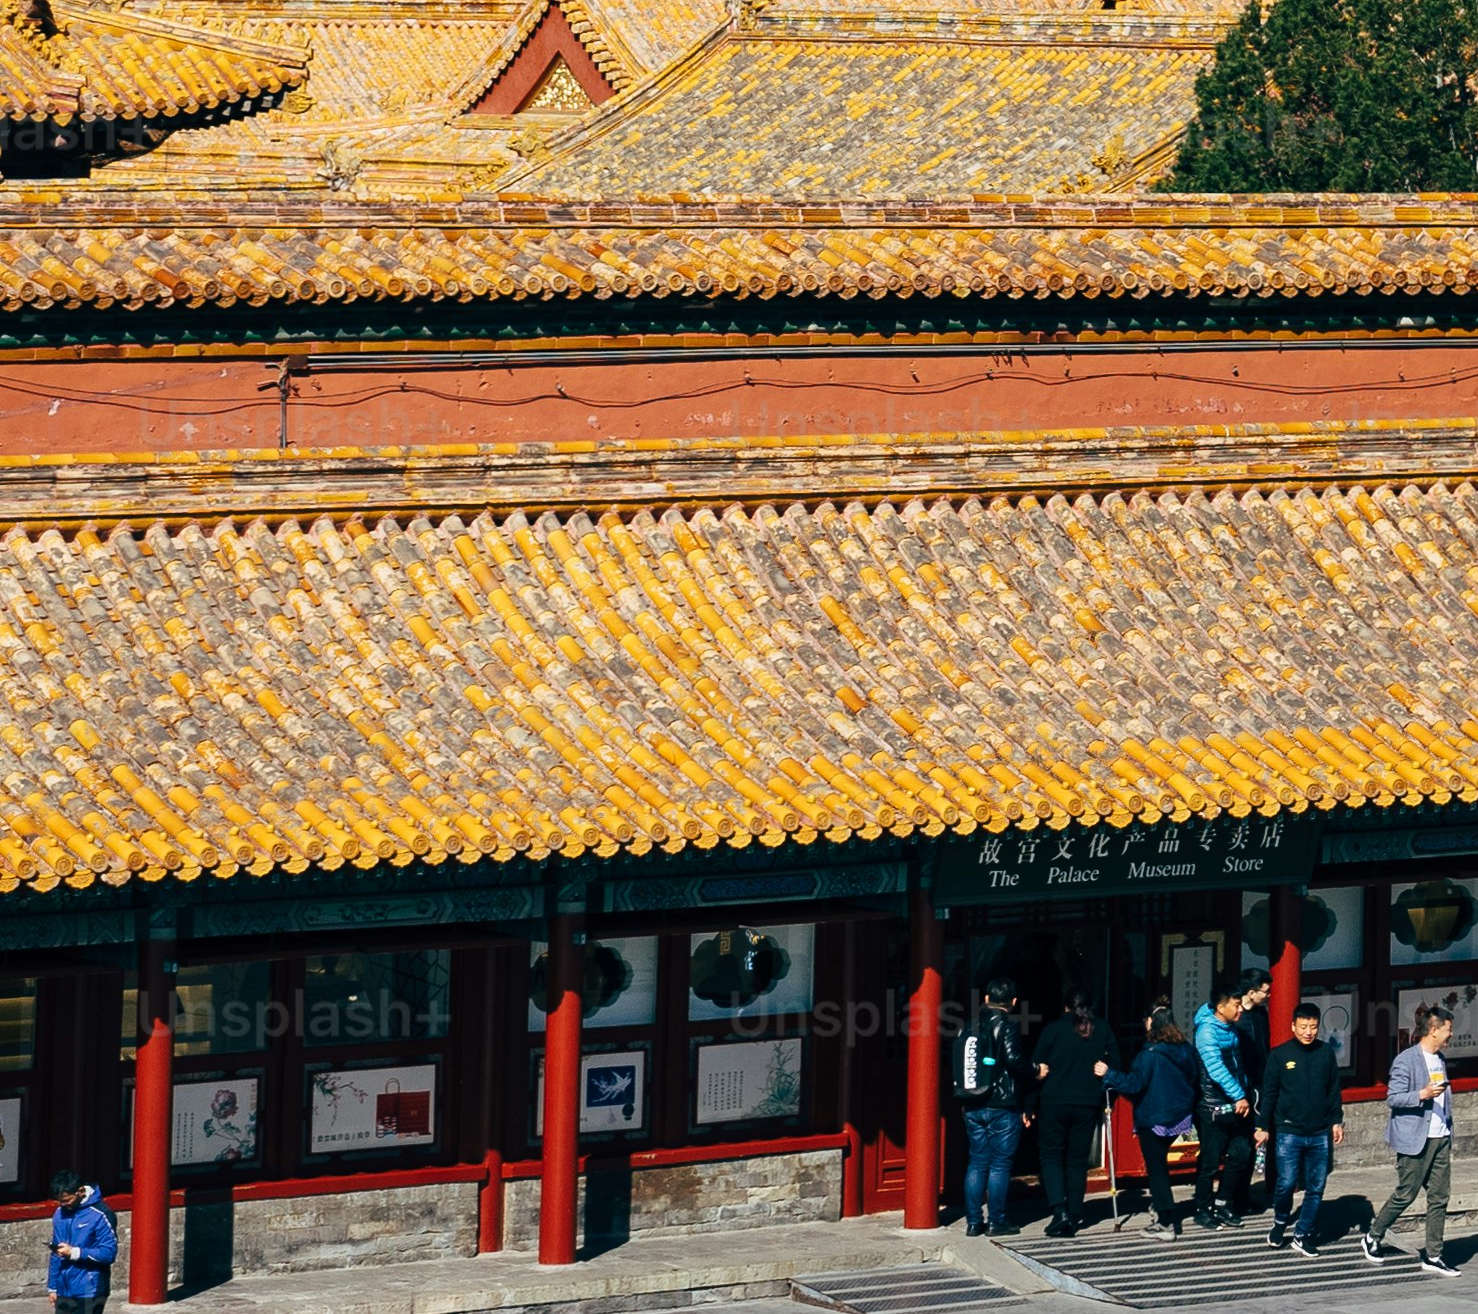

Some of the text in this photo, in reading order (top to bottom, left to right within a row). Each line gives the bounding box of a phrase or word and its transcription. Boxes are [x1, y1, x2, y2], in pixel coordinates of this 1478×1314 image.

[978, 822, 1285, 864] 故宫文化产品专卖店
[988, 855, 1264, 887] The Palace Museum Store
[966, 1039, 977, 1085] adidas
